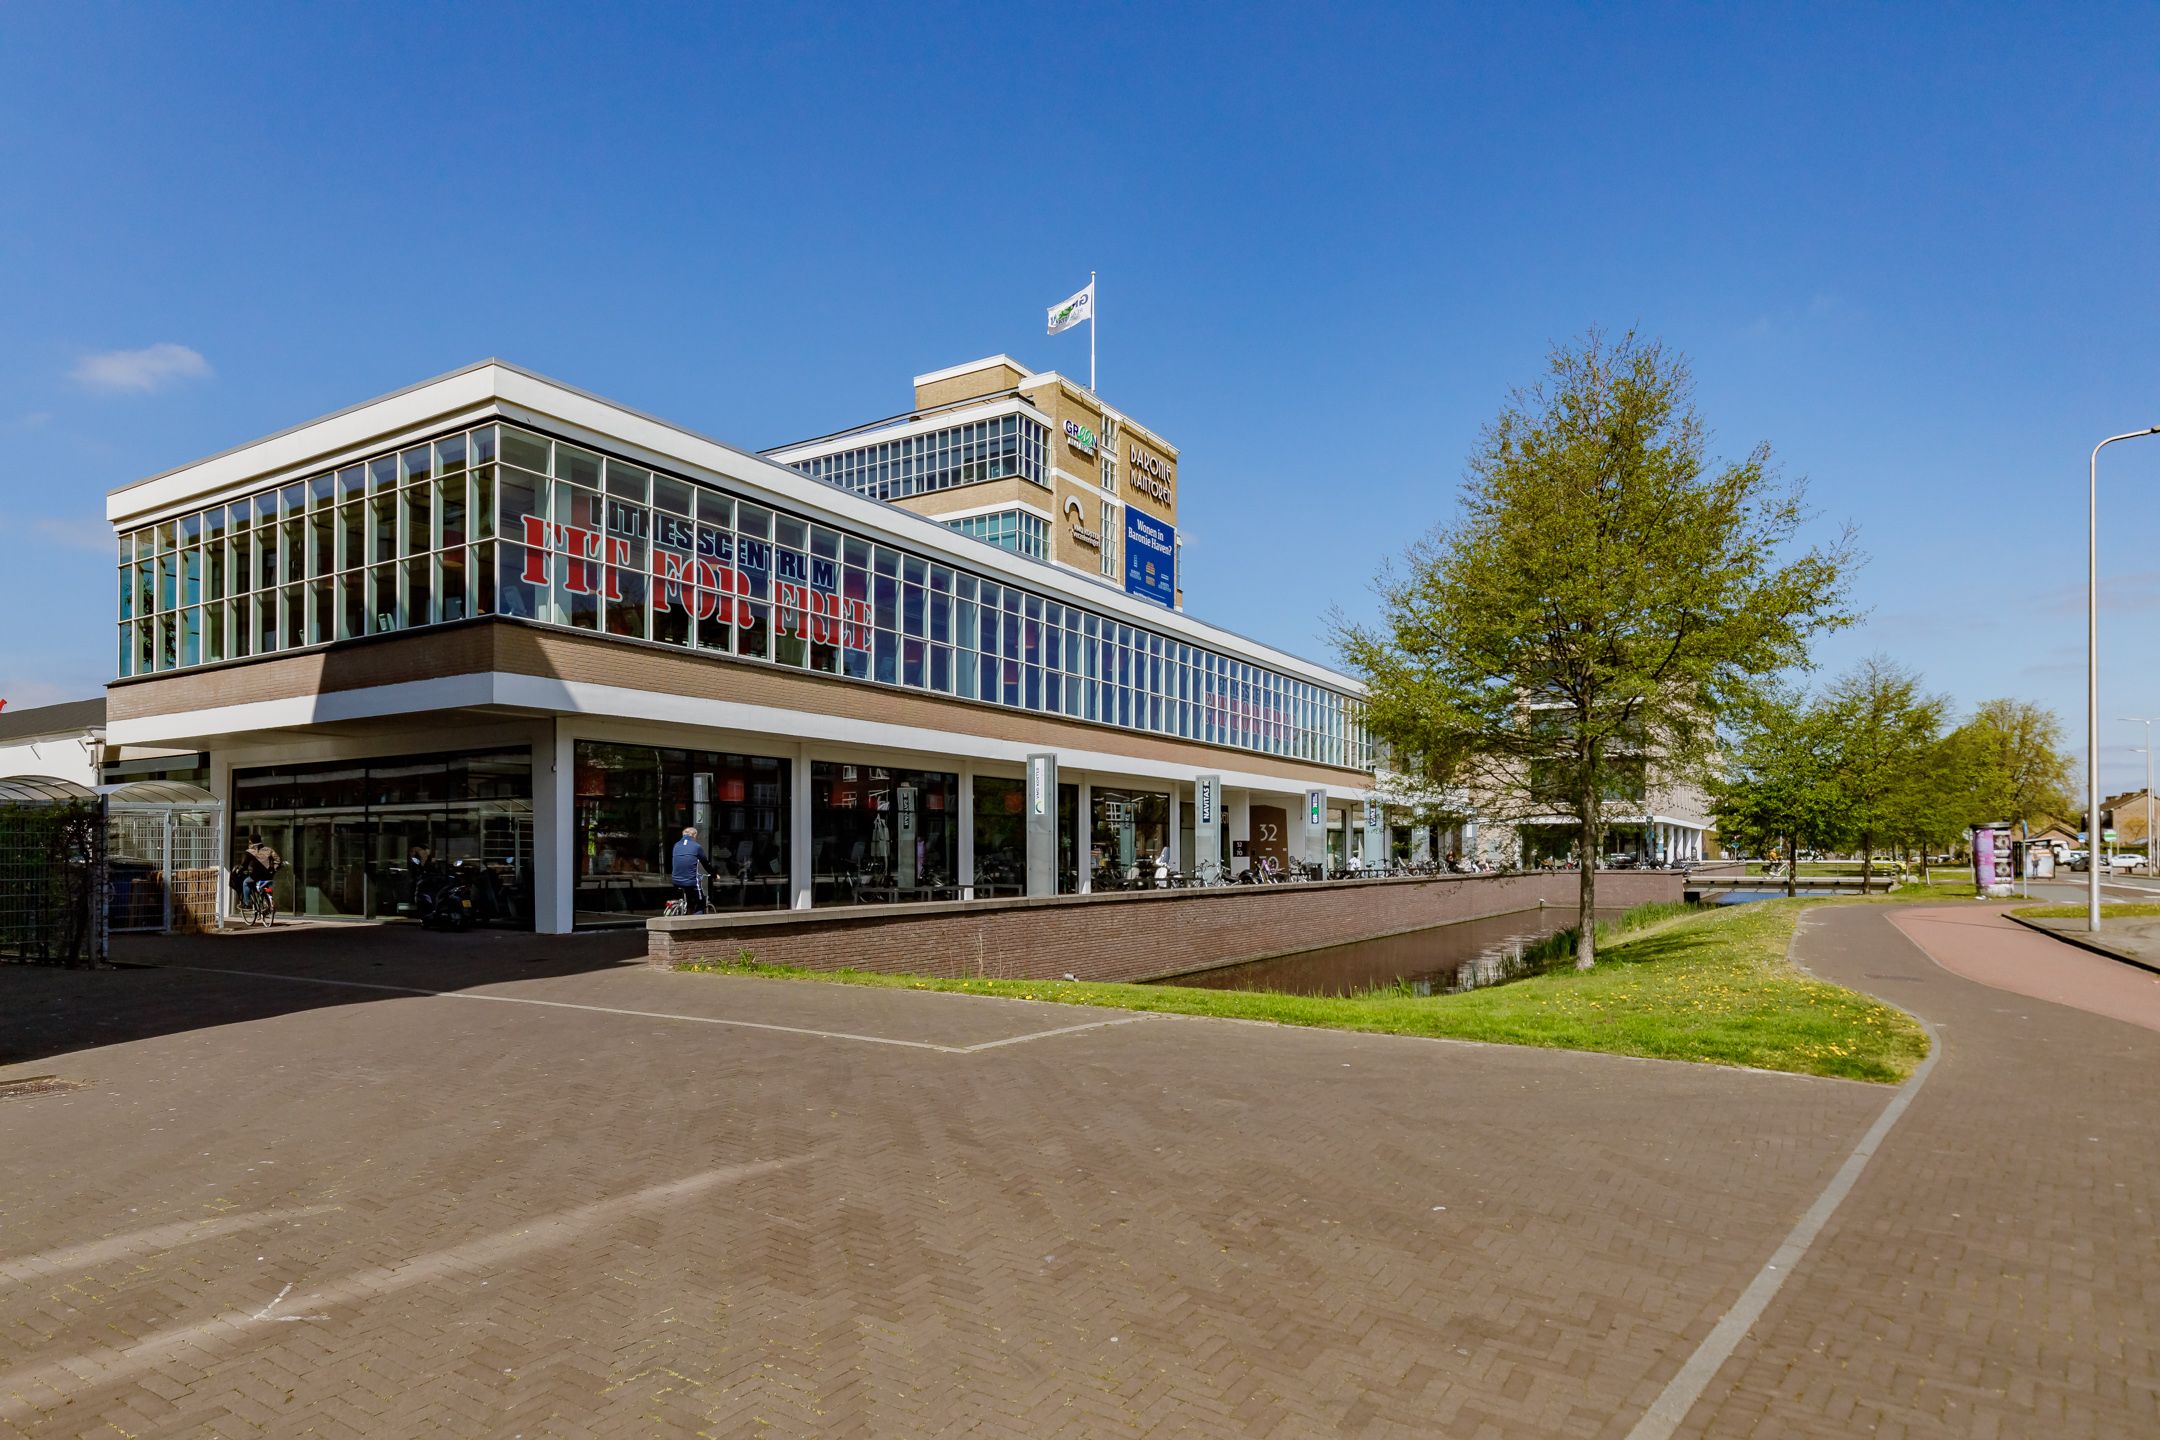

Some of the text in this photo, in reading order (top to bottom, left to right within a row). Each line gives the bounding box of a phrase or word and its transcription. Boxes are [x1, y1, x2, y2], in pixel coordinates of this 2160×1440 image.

[1130, 443, 1171, 484] BARONIE
[1130, 469, 1172, 504] KANTOREN
[590, 495, 834, 589] FITNESSCENTRUM
[1128, 527, 1173, 556] Baronie Haven?
[1137, 519, 1164, 542] Wonen in
[520, 514, 873, 654] FIT FOR FREE
[1259, 823, 1278, 842] 32
